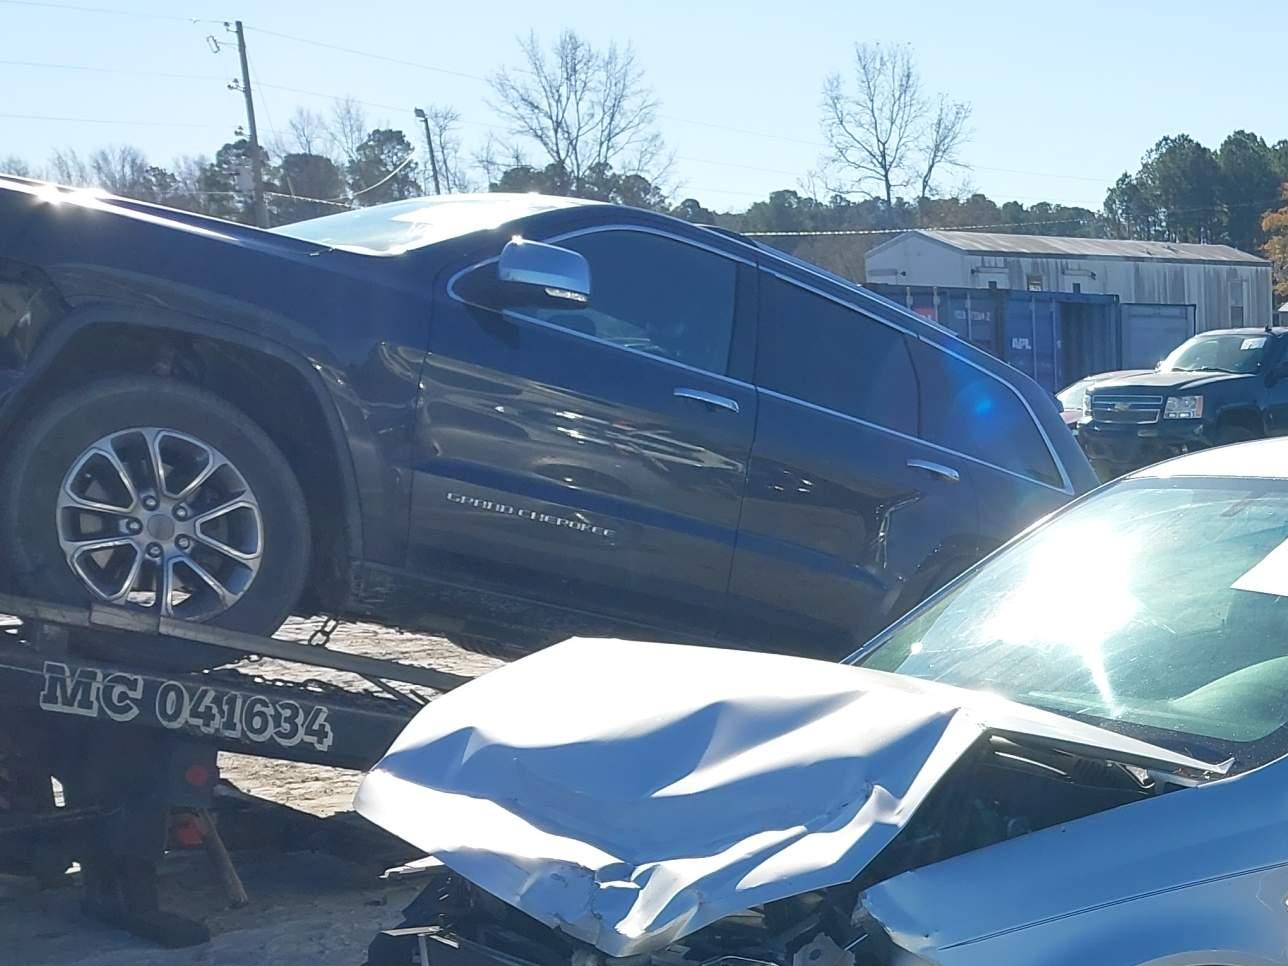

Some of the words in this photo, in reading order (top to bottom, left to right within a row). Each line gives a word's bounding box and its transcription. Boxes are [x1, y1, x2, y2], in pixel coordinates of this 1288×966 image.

[1012, 337, 1032, 350] APL
[447, 492, 513, 515] GRAND
[518, 509, 617, 538] CHEROKEE
[40, 660, 144, 722] MC
[156, 680, 333, 752] 041634
